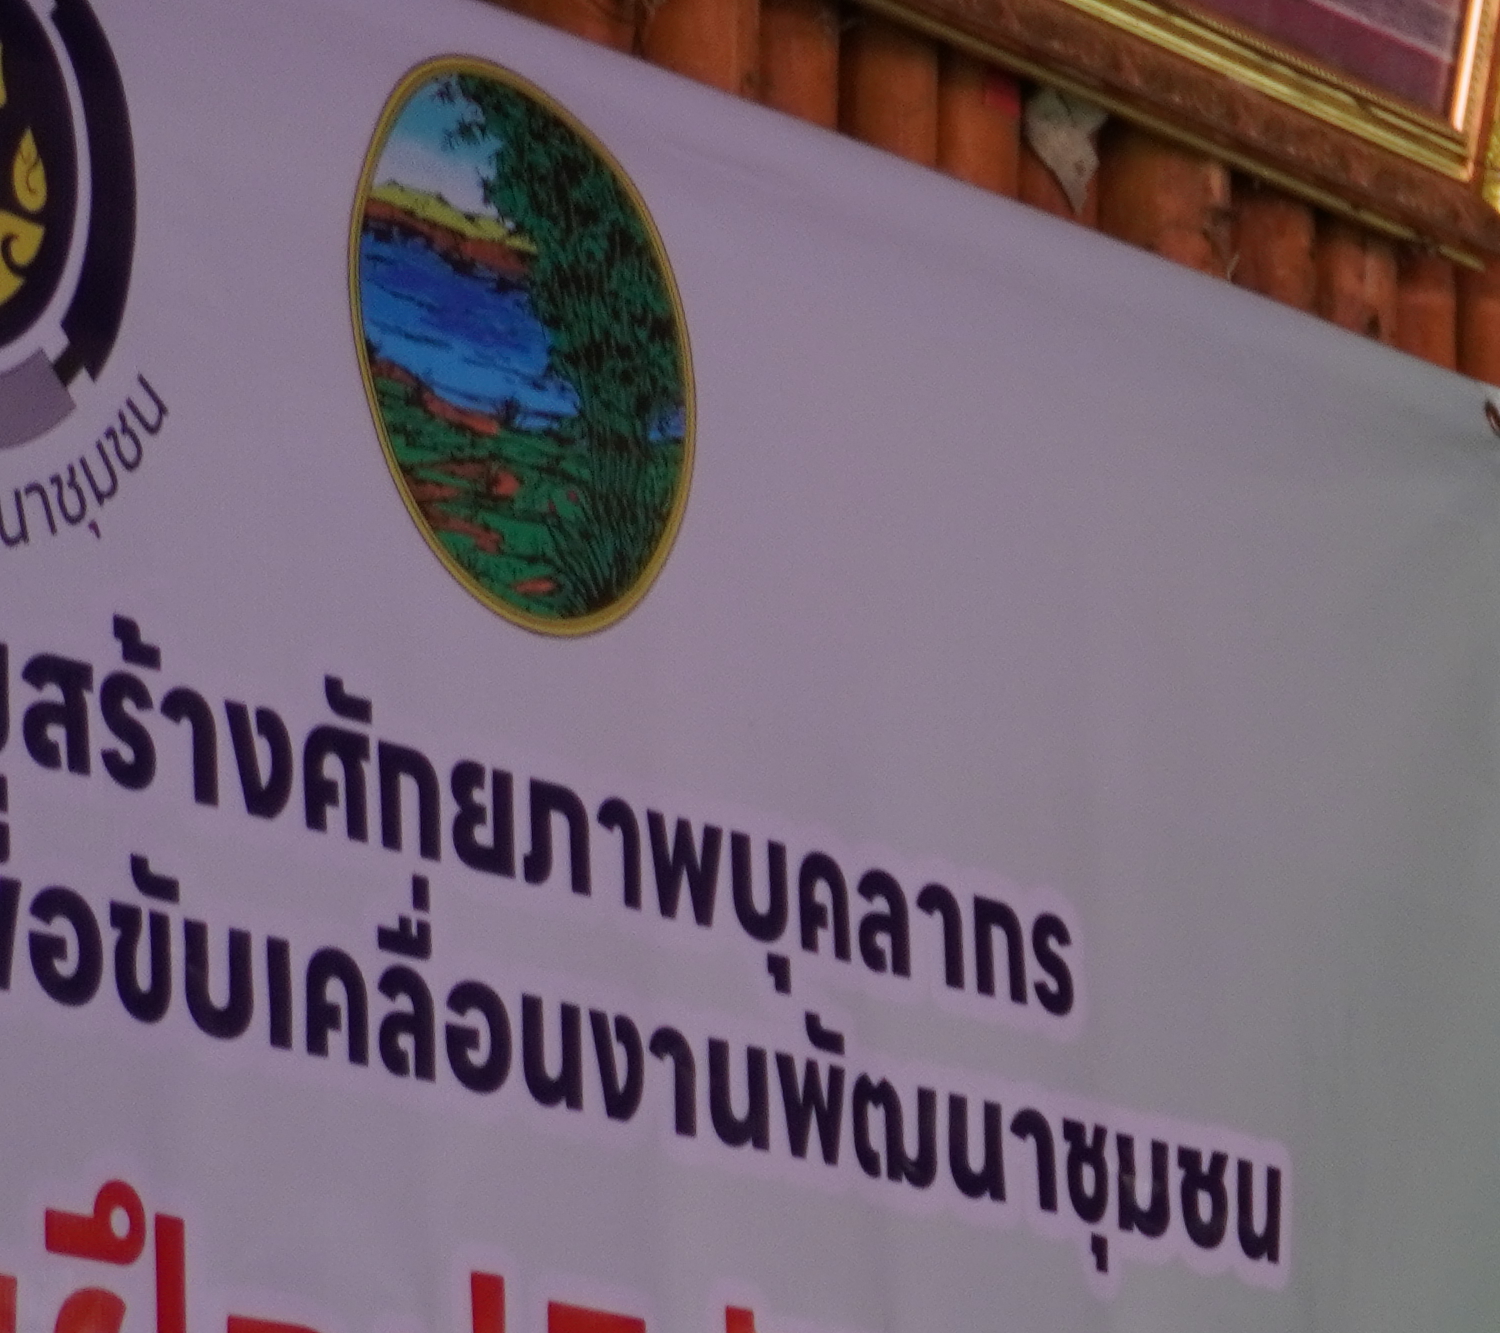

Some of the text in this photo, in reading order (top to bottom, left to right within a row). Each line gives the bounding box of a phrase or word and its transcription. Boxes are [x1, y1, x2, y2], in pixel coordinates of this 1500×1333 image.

[0, 614, 1076, 1016] สร้างศักยภาพบุคลากร
[0, 775, 1283, 1271] อขับเคลื่อนงานพัฒนาชุมชน
